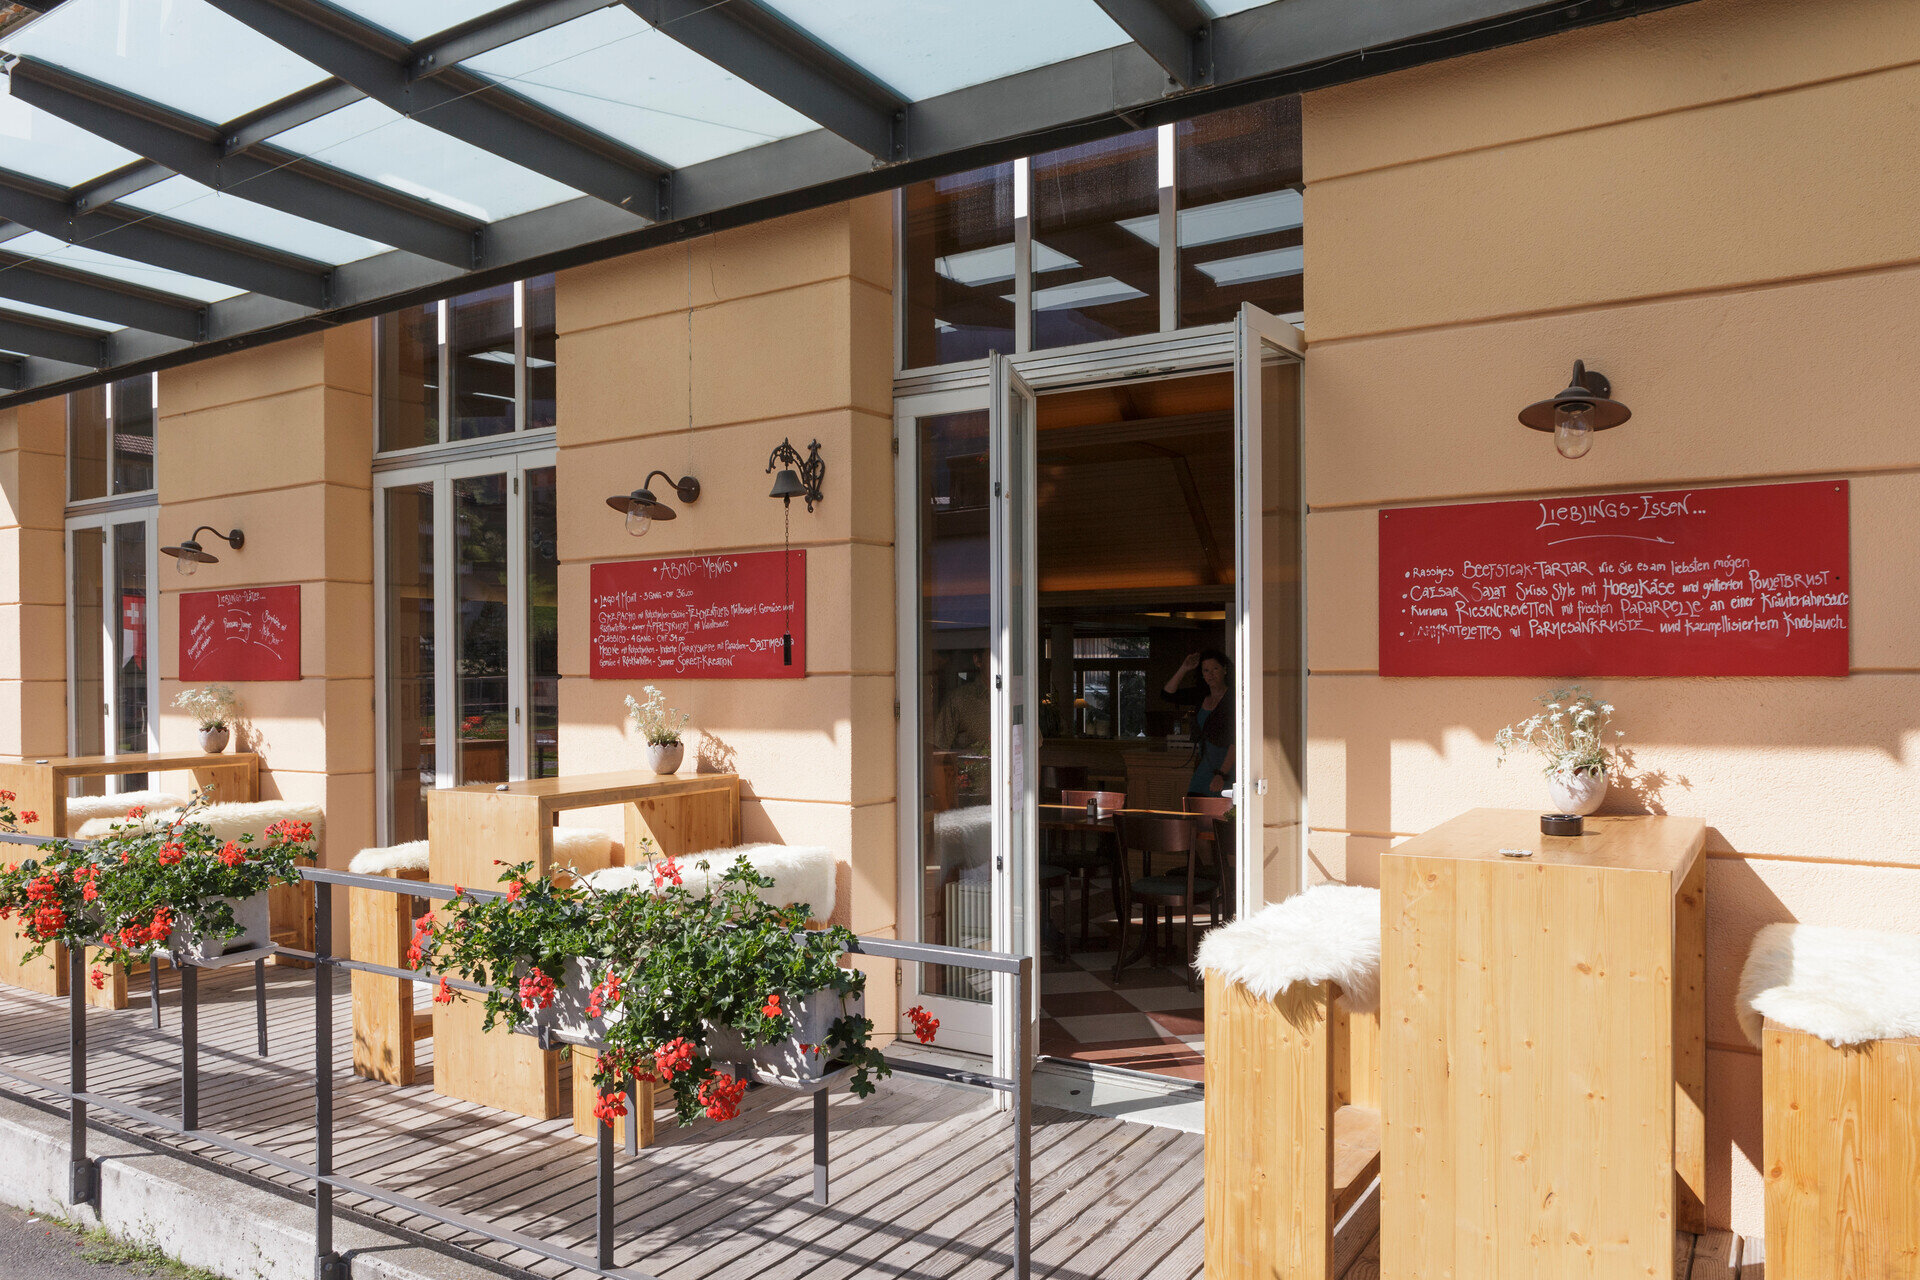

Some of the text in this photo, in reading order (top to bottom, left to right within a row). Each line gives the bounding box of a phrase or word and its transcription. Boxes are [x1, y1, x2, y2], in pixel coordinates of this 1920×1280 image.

[1412, 565, 1455, 584] Rassiges
[1617, 560, 1633, 575] Sie
[1671, 556, 1710, 575] liebsten
[1713, 554, 1751, 577] mögen
[1515, 581, 1549, 601] Swiss
[1551, 582, 1576, 602] Style
[1581, 582, 1597, 597] mit
[1682, 580, 1700, 594] und
[1411, 604, 1448, 618] Kuruma
[1561, 602, 1574, 616] mit
[1577, 601, 1614, 622] frischen
[1709, 600, 1725, 612] an
[1730, 595, 1755, 610] einer
[1760, 590, 1850, 614] Kräuterrahmsauce
[1509, 624, 1521, 638] mit
[1660, 619, 1681, 634] und
[1782, 611, 1847, 638] Knoblauch
